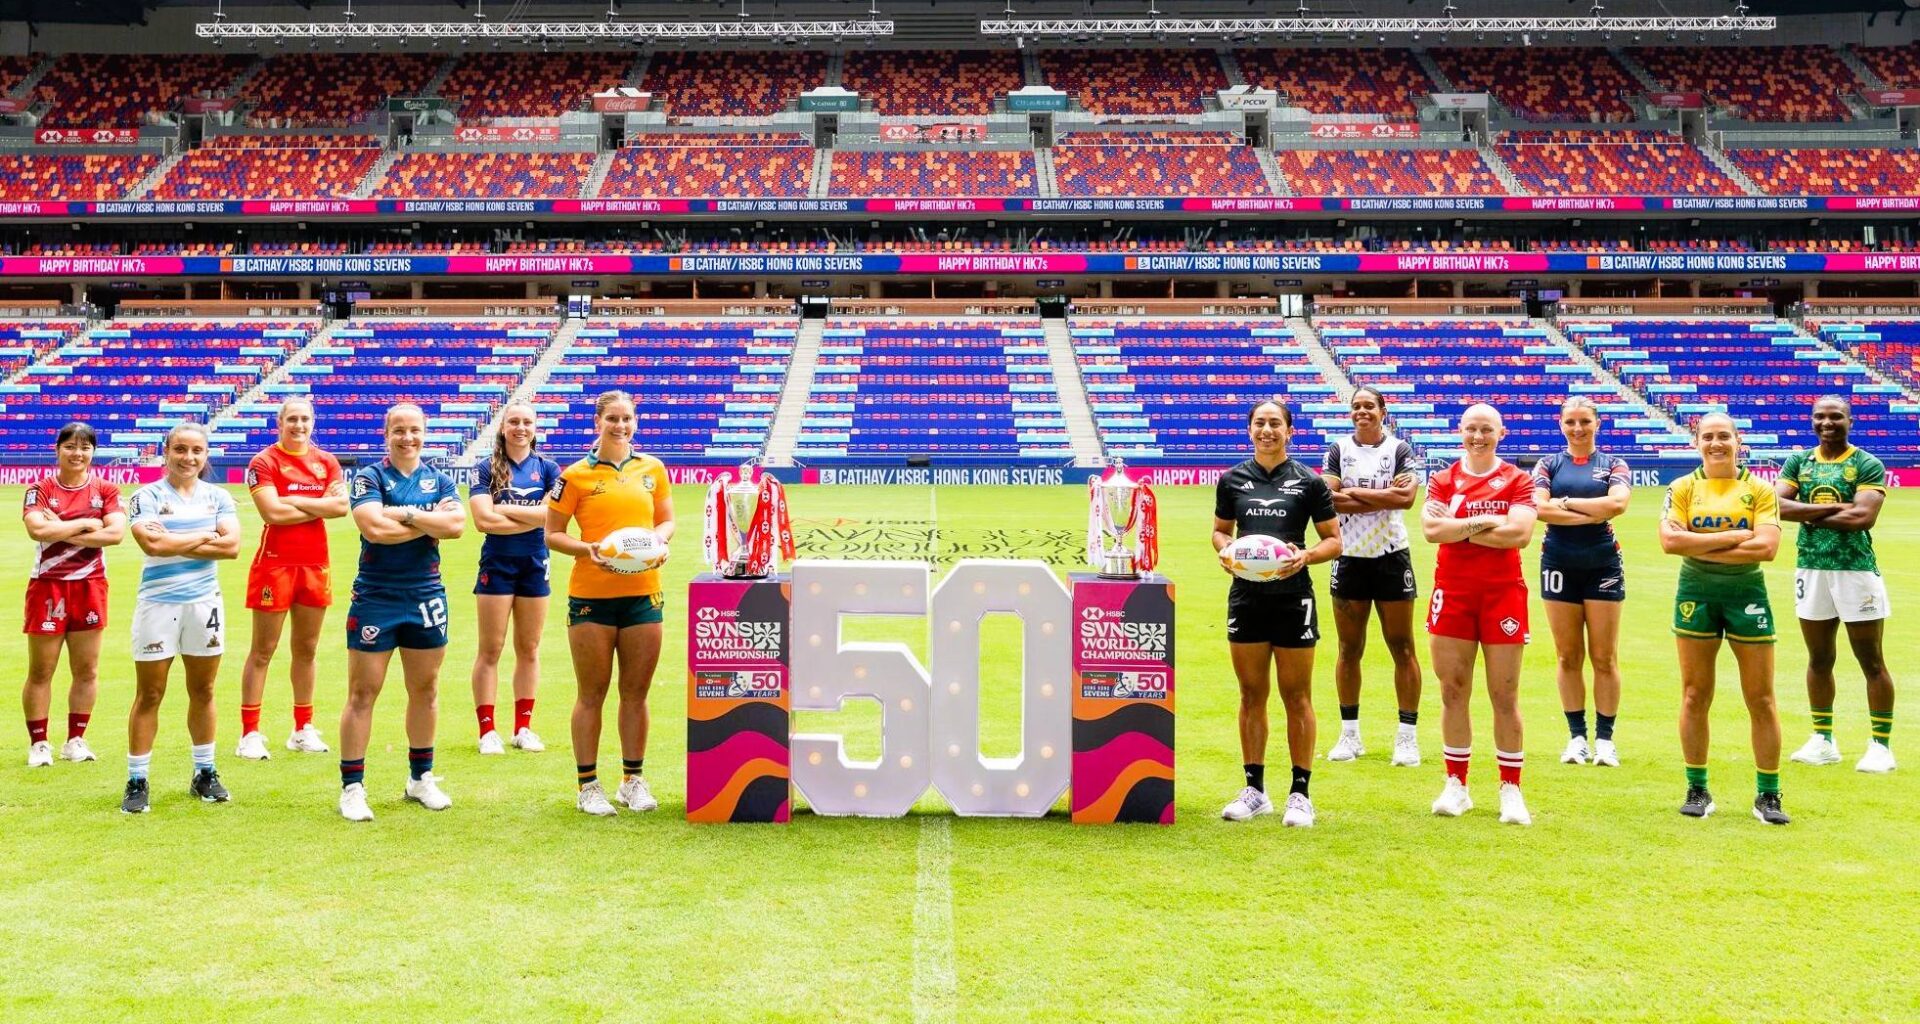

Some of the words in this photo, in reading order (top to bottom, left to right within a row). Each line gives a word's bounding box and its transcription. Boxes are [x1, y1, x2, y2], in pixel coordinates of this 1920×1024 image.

[23, 203, 41, 213] HK7s
[106, 203, 154, 213] CATHAY/HSBC
[156, 203, 175, 213] HONG
[177, 203, 196, 212] KONG
[197, 203, 224, 212] SEVENS
[271, 202, 293, 212] HAPPY
[295, 202, 330, 212] BIRTHDAY
[332, 202, 348, 212] HK7s
[416, 202, 463, 212] CATHAY/HSBC
[465, 202, 484, 212] HONG
[486, 202, 505, 211] KONG
[507, 202, 534, 211] SEVENS
[581, 201, 604, 211] HAPPY
[606, 201, 641, 211] BIRTHDAY
[643, 201, 660, 211] HK7s
[728, 201, 776, 211] CATHAY/HSBC
[778, 201, 797, 211] HONG
[799, 201, 818, 210] KONG
[820, 201, 847, 210] SEVENS
[895, 201, 918, 210] HAPPY
[920, 200, 955, 210] BIRTHDAY
[957, 200, 975, 210] HK7s
[1042, 200, 1092, 210] CATHAY/HSBC
[1094, 200, 1113, 210] HONG
[1115, 200, 1134, 210] KONG
[1136, 200, 1164, 210] SEVENS
[1212, 200, 1235, 209] HAPPY
[1237, 200, 1272, 209] BIRTHDAY
[1274, 199, 1293, 209] HK7s
[1361, 199, 1411, 209] CATHAY/HSBC
[1413, 199, 1433, 209] HONG
[1435, 199, 1454, 209] KONG
[1456, 199, 1484, 209] SEVENS
[1533, 199, 1556, 209] HAPPY
[1558, 199, 1594, 208] BIRTHDAY
[1596, 199, 1615, 208] HK7s
[1684, 199, 1734, 208] CATHAY/HSBC
[1736, 199, 1755, 208] HONG
[1757, 198, 1777, 208] KONG
[1779, 198, 1807, 208] SEVENS
[1856, 198, 1880, 208] HAPPY
[1883, 198, 1919, 208] BIRTHDAY
[40, 259, 71, 272] HAPPY
[73, 259, 120, 272] BIRTHDAY
[122, 259, 145, 272] HK7s
[247, 259, 313, 272] CATHAY/HSBC
[316, 259, 342, 272] HONG
[345, 259, 371, 271] KONG
[374, 259, 411, 271] SEVENS
[486, 258, 517, 271] HAPPY
[520, 258, 567, 271] BIRTHDAY
[569, 258, 593, 271] HK7s
[696, 258, 764, 271] CATHAY/HSBC
[767, 258, 793, 270] HONG
[796, 257, 822, 270] KONG
[825, 257, 862, 270] SEVENS
[939, 257, 970, 270] HAPPY
[973, 257, 1020, 270] BIRTHDAY
[1023, 257, 1048, 270] HK7s
[1152, 257, 1220, 270] CATHAY/HSBC
[1223, 257, 1250, 270] HONG
[1253, 257, 1279, 270] KONG
[1282, 257, 1321, 270] SEVENS
[1399, 256, 1430, 269] HAPPY
[1433, 256, 1481, 269] BIRTHDAY
[1484, 256, 1509, 269] HK7s
[1615, 256, 1684, 269] CATHAY/HSBC
[1687, 256, 1714, 269] HONG
[1717, 256, 1744, 269] KONG
[1747, 256, 1786, 269] SEVENS
[1865, 256, 1897, 269] HAPPY
[0, 468, 41, 485] HAPPY
[109, 468, 140, 484] HK7s
[681, 468, 713, 485] HK7s
[838, 469, 930, 485] CATHAY/HSBC
[933, 469, 969, 485] HONG
[972, 469, 1009, 485] KONG
[1012, 469, 1063, 485] SEVENS
[1153, 469, 1196, 485] HAPPY
[1246, 508, 1287, 518] ALTRAD
[1542, 569, 1564, 594] 10
[1432, 588, 1444, 614] 9
[45, 597, 67, 622] 14
[418, 597, 447, 628] 12
[1105, 610, 1126, 618] HSBC
[1301, 598, 1313, 626] 7
[206, 607, 220, 632] 4
[695, 621, 754, 638] SVNS
[1081, 621, 1139, 638] SVNS
[696, 638, 754, 650] WORLD
[1081, 638, 1139, 650] WORLD
[696, 650, 781, 660] CHAMPIONSHIP
[1081, 650, 1166, 661] CHAMPIONSHIP
[751, 672, 780, 690] 50
[1137, 673, 1165, 691] 50
[791, 559, 1073, 817] 50
